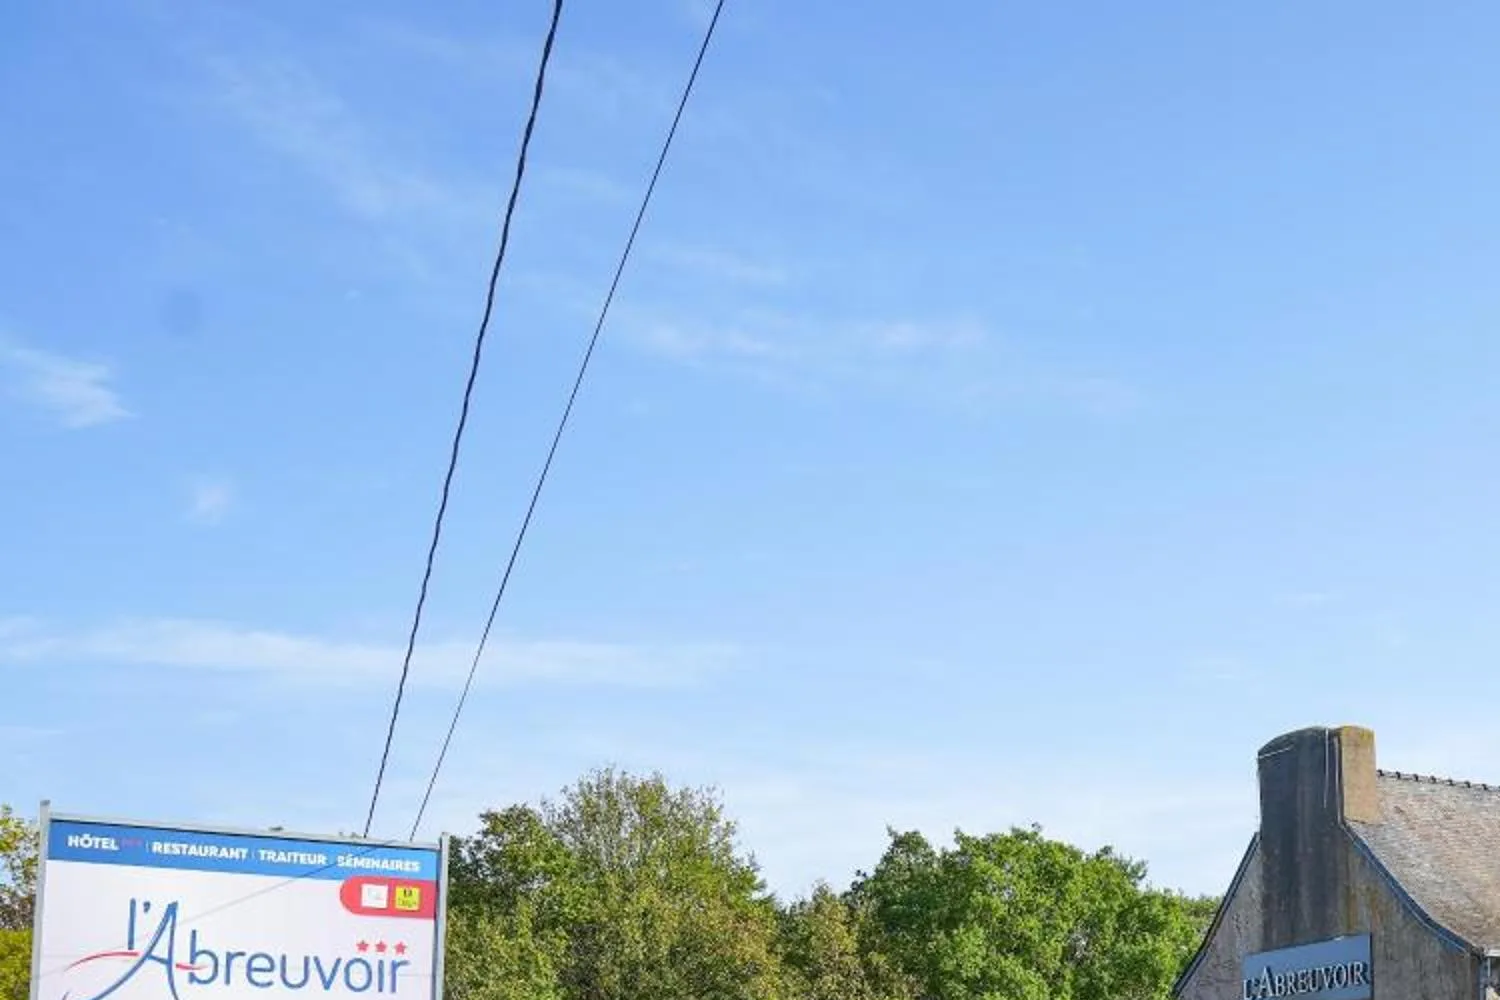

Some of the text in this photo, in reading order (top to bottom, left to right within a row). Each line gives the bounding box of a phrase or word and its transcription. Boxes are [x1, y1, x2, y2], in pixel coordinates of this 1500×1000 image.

[67, 833, 421, 872] HÔTEL RESTAURANT TRAITEUR SÉMINAIRES
